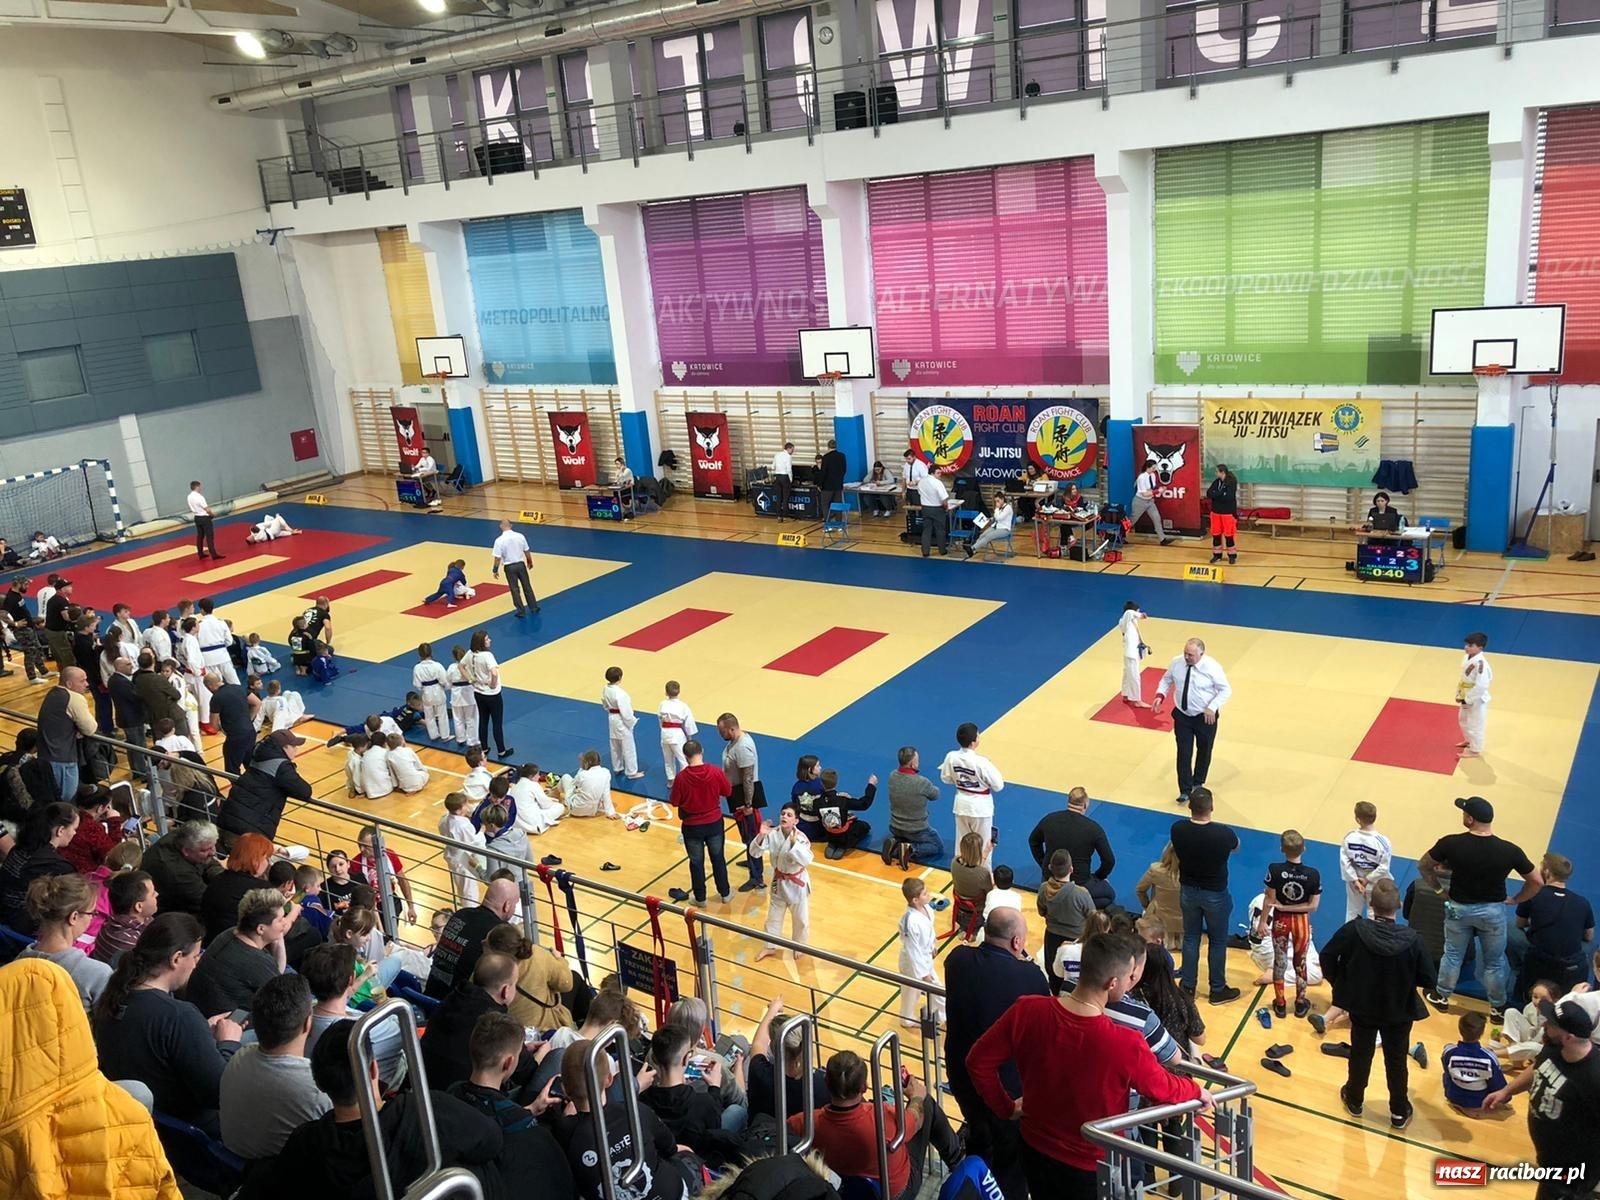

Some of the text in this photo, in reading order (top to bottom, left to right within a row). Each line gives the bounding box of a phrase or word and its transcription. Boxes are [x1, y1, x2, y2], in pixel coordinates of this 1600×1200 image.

[1206, 353, 1262, 362] KATOWICE
[690, 362, 723, 370] KATOWICE
[914, 361, 957, 369] KATOWICE
[912, 406, 968, 431] ROAN FIGHT CLUB
[973, 405, 1026, 422] ROAN
[1213, 407, 1323, 430] ŚLĄSKI ZWIĄZEK
[1030, 407, 1093, 434] ROAN FIGHT CLUB
[973, 422, 1026, 433] FIGHT CLUB
[1233, 426, 1248, 438] JU
[1256, 426, 1289, 439] JITSU
[978, 446, 1022, 459] JU-JITSU
[561, 455, 586, 466] Wolf
[698, 459, 723, 470] Wolf
[1044, 466, 1082, 479] KATOWICE
[1155, 487, 1186, 499] olf
[533, 511, 539, 521] 3
[795, 535, 802, 545] 2
[1396, 550, 1405, 558] 2
[1407, 548, 1419, 559] 3
[1388, 557, 1397, 565] 2
[1406, 559, 1419, 571] 3
[1189, 566, 1217, 580] MATA 1
[1372, 568, 1405, 579] 0:40
[1460, 1070, 1480, 1078] POL
